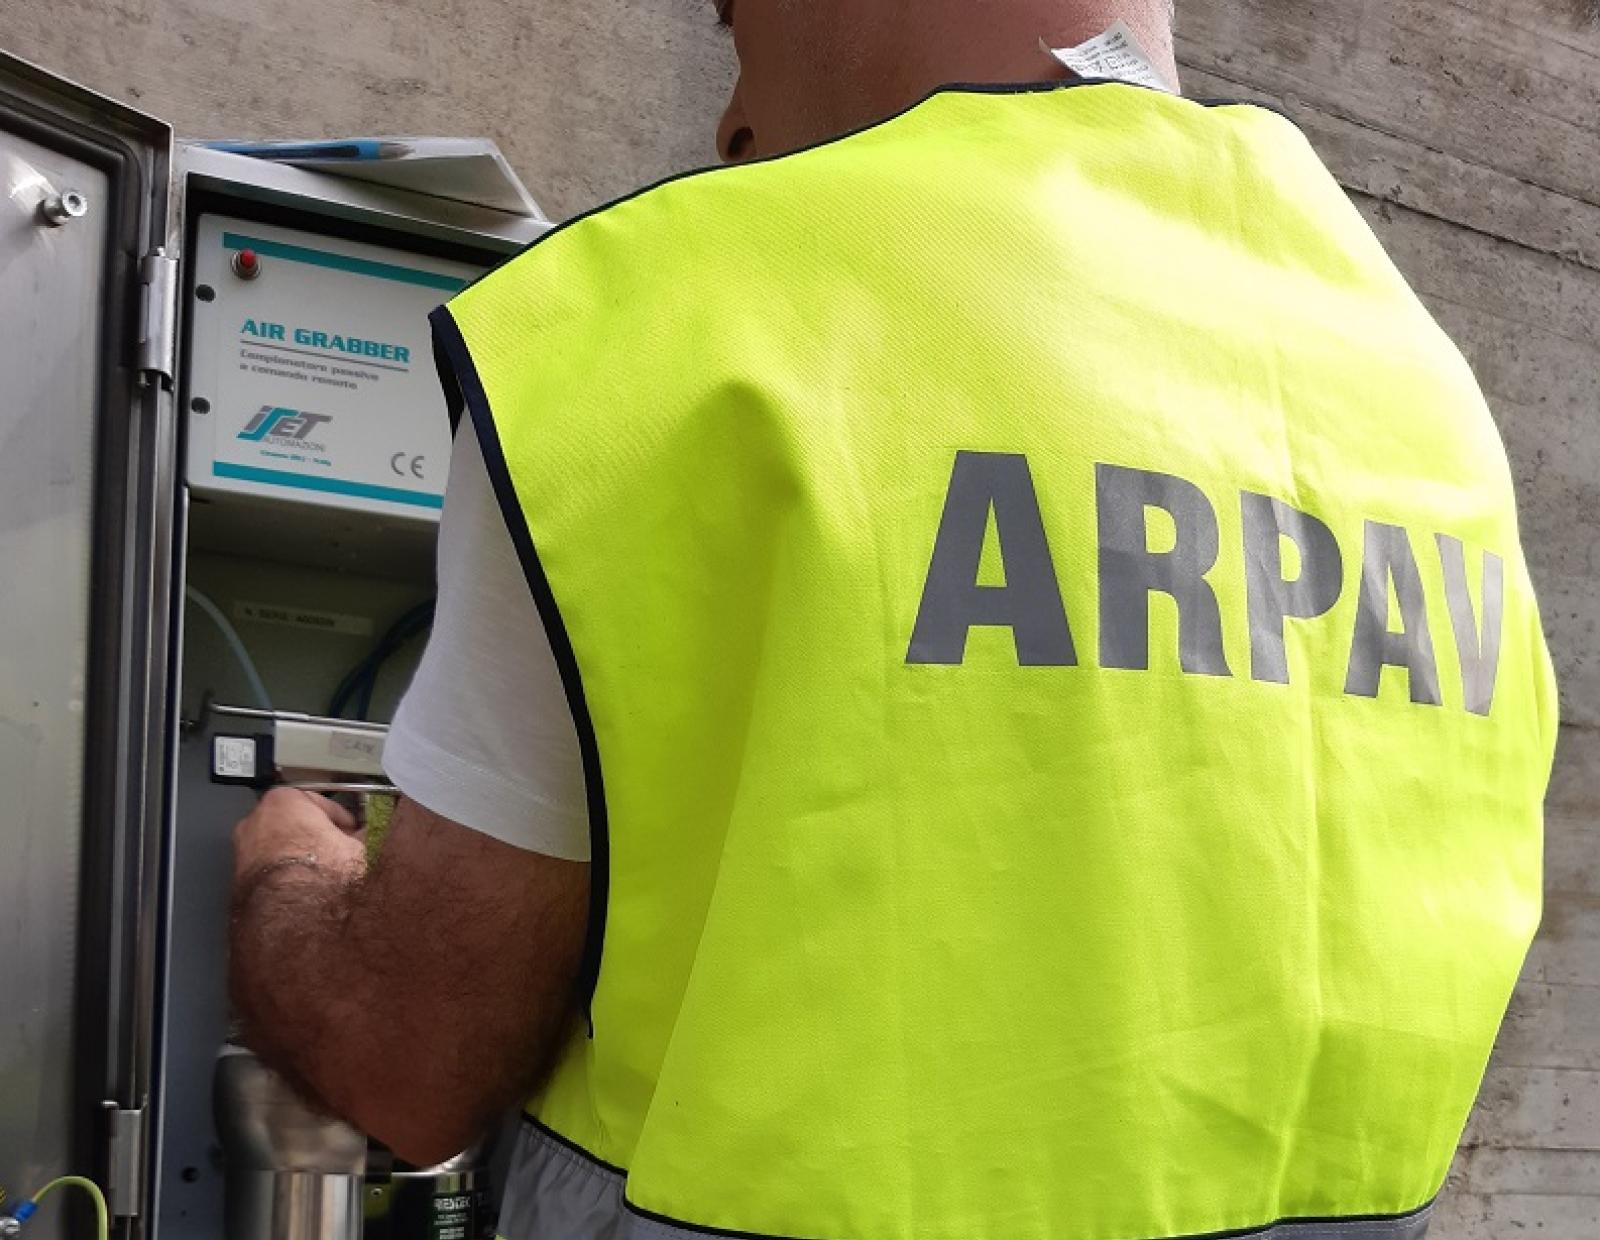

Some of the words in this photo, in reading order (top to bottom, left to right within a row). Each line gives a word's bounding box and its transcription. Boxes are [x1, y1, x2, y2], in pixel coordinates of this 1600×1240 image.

[240, 318, 286, 341] AIR
[294, 328, 410, 363] GRABBER
[904, 449, 1504, 717] ARPAV
